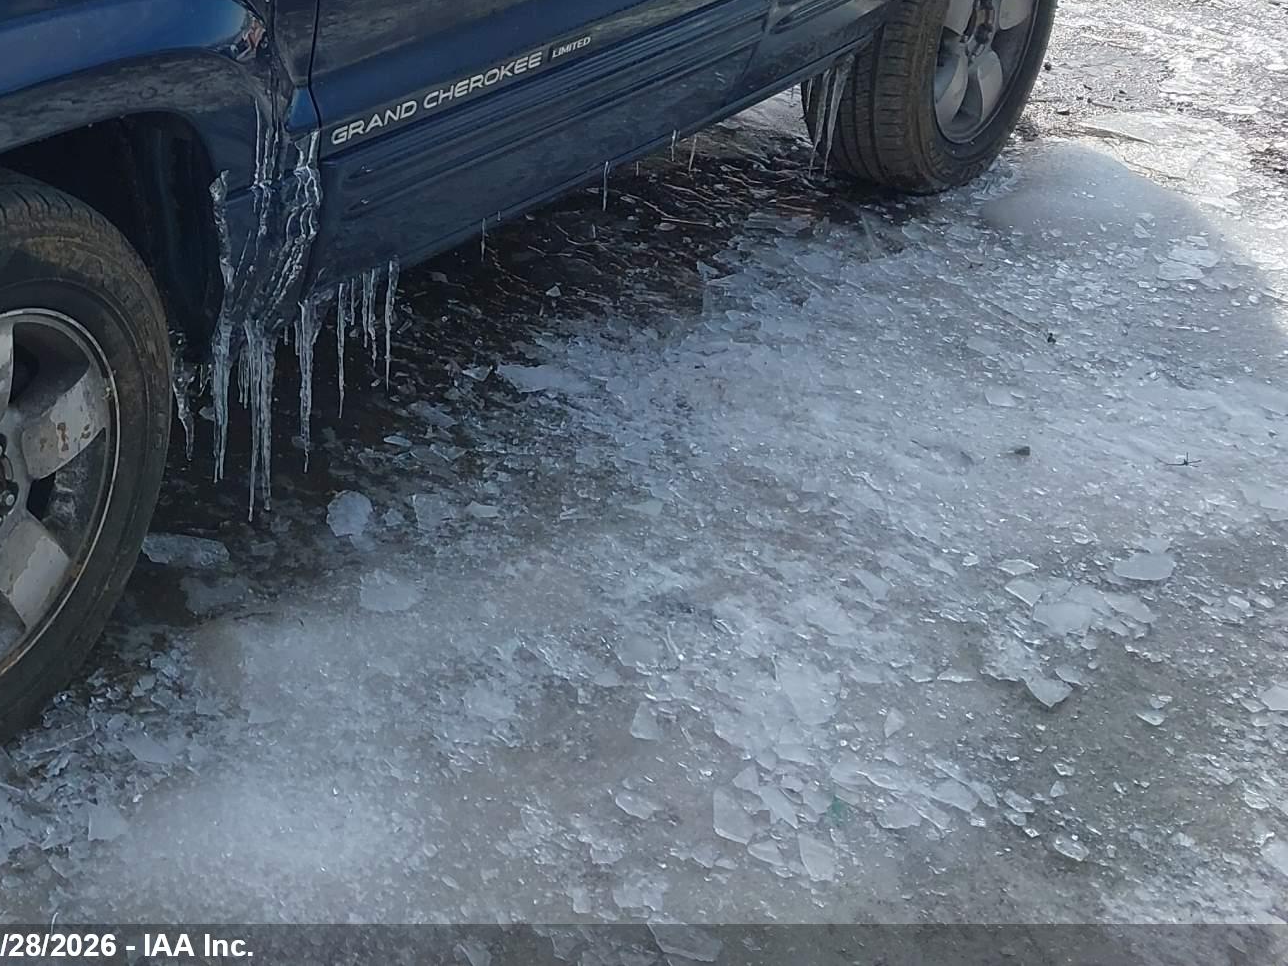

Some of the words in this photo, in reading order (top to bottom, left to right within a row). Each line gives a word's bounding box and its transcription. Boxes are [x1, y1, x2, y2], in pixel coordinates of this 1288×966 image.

[331, 99, 417, 145] GRAND
[423, 51, 543, 110] CHEROKEE
[551, 35, 592, 59] LIMITED
